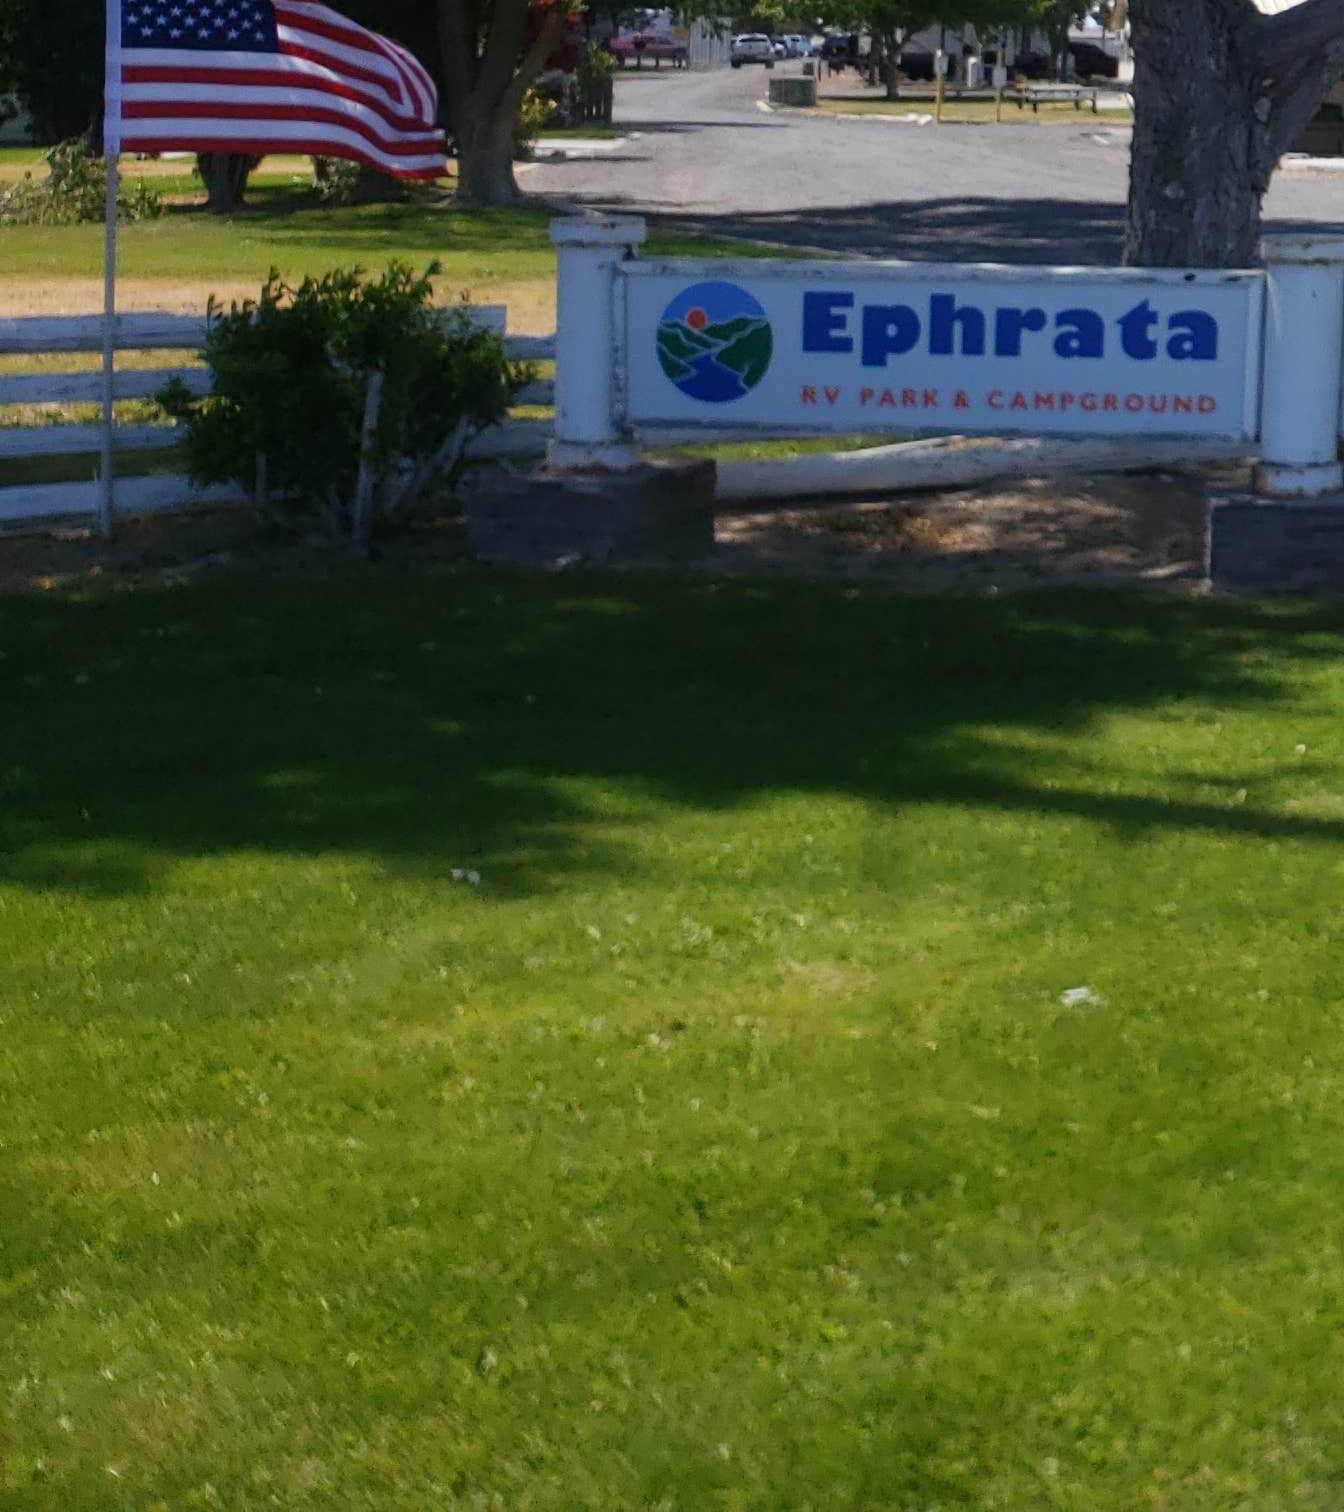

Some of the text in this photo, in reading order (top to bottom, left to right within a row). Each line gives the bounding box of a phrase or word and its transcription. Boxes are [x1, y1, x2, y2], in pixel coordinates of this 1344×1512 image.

[802, 291, 1218, 367] Ephrata
[801, 385, 1217, 413] RV PARK & CAMPGROUND
